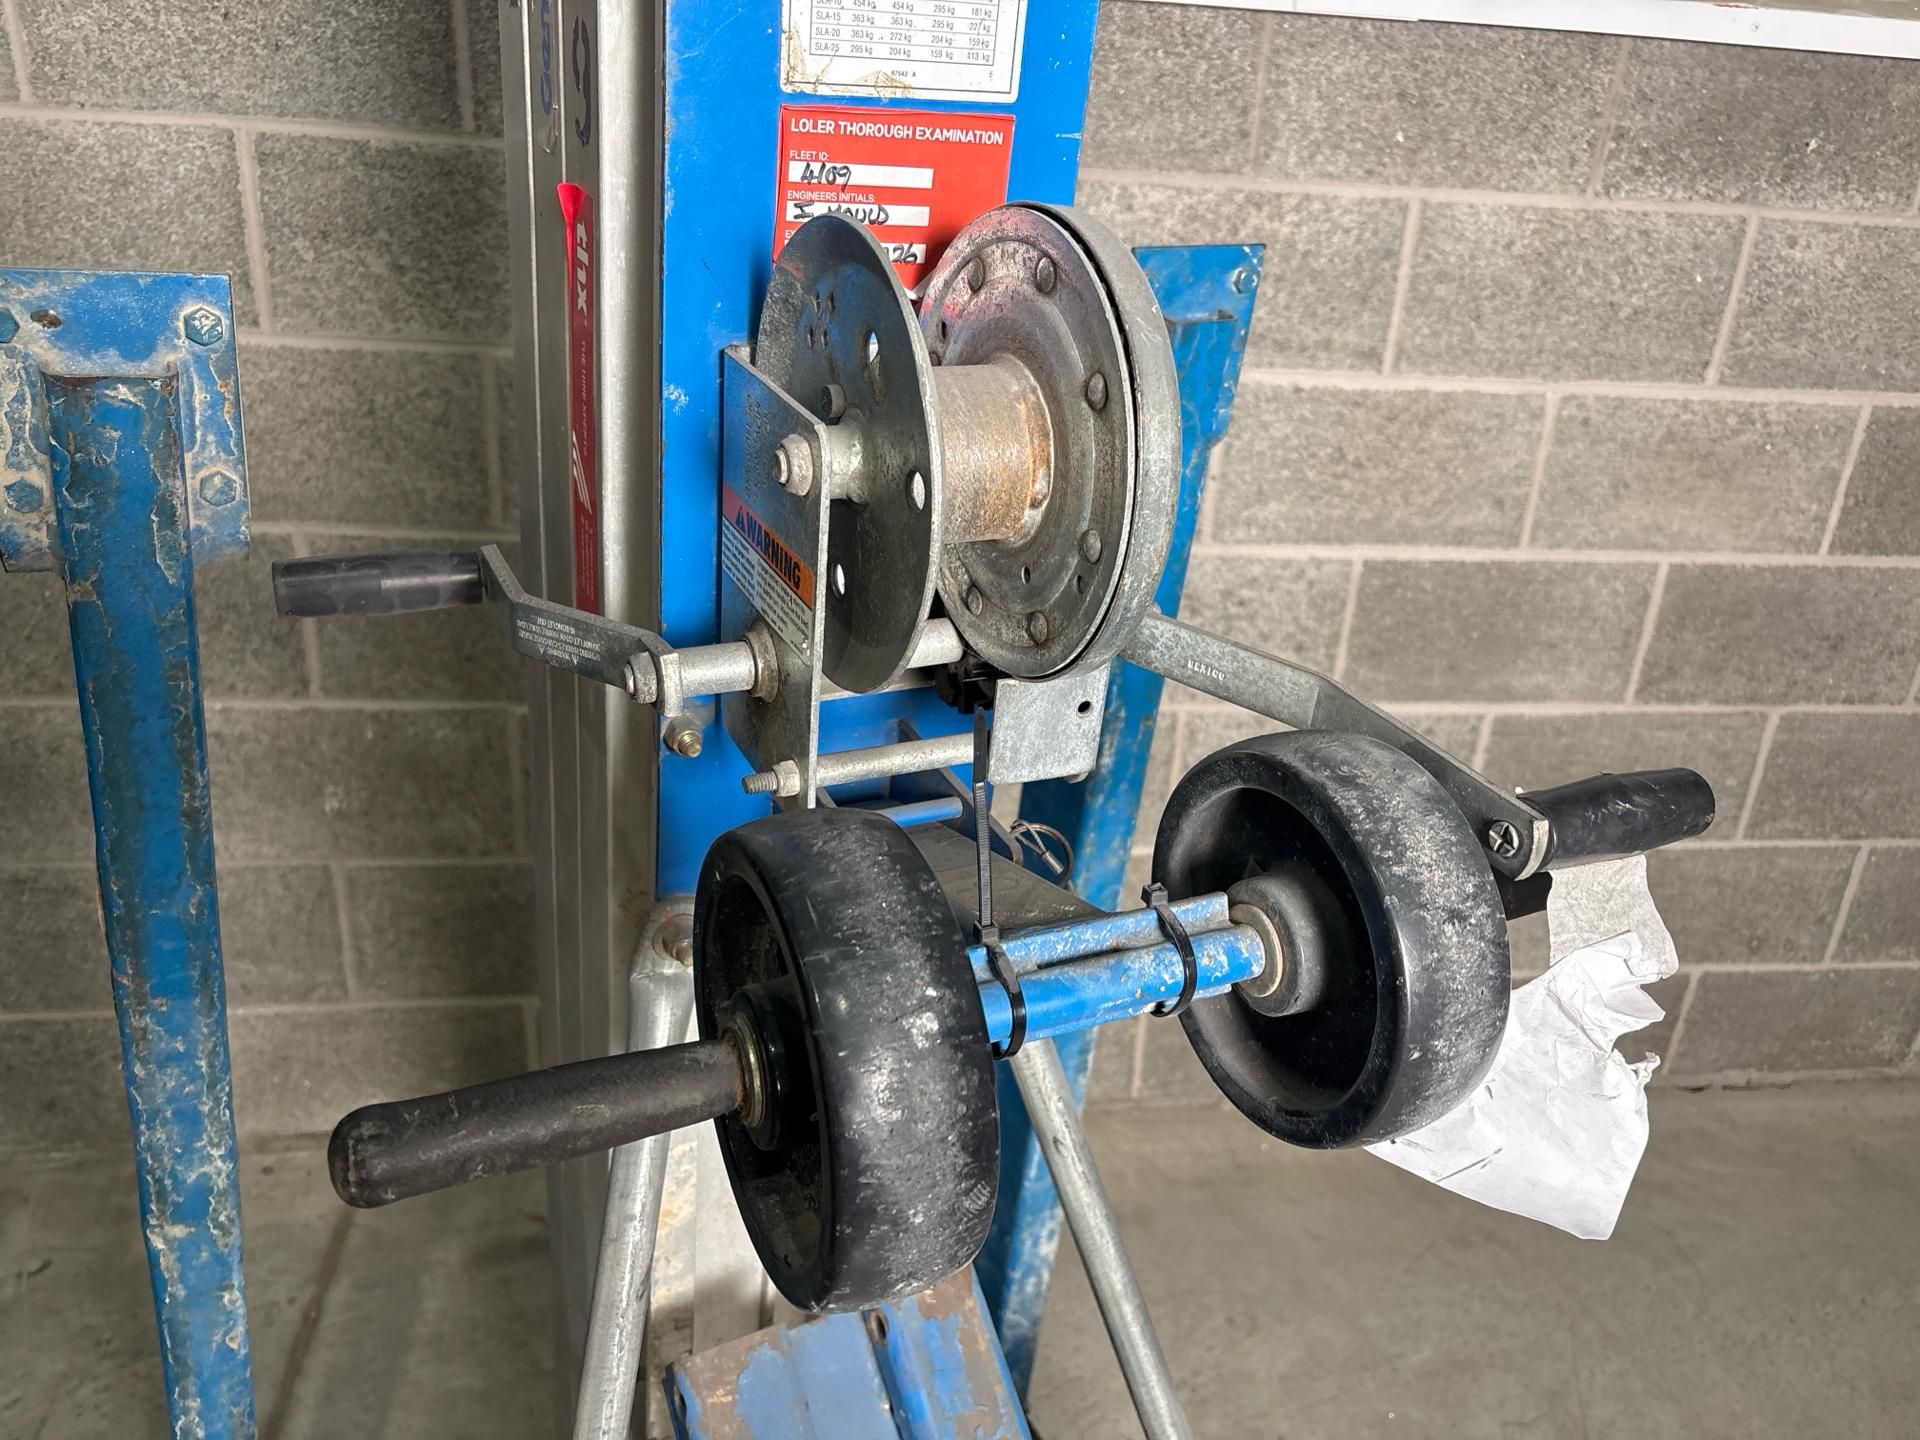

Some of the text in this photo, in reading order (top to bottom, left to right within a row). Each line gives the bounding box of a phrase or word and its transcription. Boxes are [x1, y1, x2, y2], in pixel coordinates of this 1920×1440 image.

[816, 10, 841, 21] SLA-15
[852, 14, 864, 22] 363
[866, 15, 875, 25] kg
[891, 17, 904, 25] 363
[904, 18, 913, 28] kg
[932, 20, 945, 28] 295
[946, 21, 954, 30] kg
[983, 24, 991, 33] kg
[892, 3, 904, 11] 454
[905, 4, 914, 13] kg
[933, 5, 946, 13] 295
[946, 6, 955, 15] kg
[971, 8, 982, 16] 181
[984, 8, 992, 18] kg
[815, 27, 990, 49] SLA-20 363 kg 272 kg 204 kg 159 kg
[815, 41, 840, 52] SLA-25
[850, 45, 862, 54] 295
[863, 46, 873, 56] kg
[889, 47, 902, 56] 204
[902, 48, 911, 59] kg
[930, 50, 943, 59] 159
[945, 52, 954, 60] kg
[983, 53, 990, 63] kg
[790, 118, 1003, 145] LOLER THOROUGH EXAMINATION
[790, 150, 829, 161] FLEET ID:
[787, 190, 837, 201] ENGINEERS
[746, 512, 802, 590] WARNING
[1188, 659, 1225, 681] MEXICO
